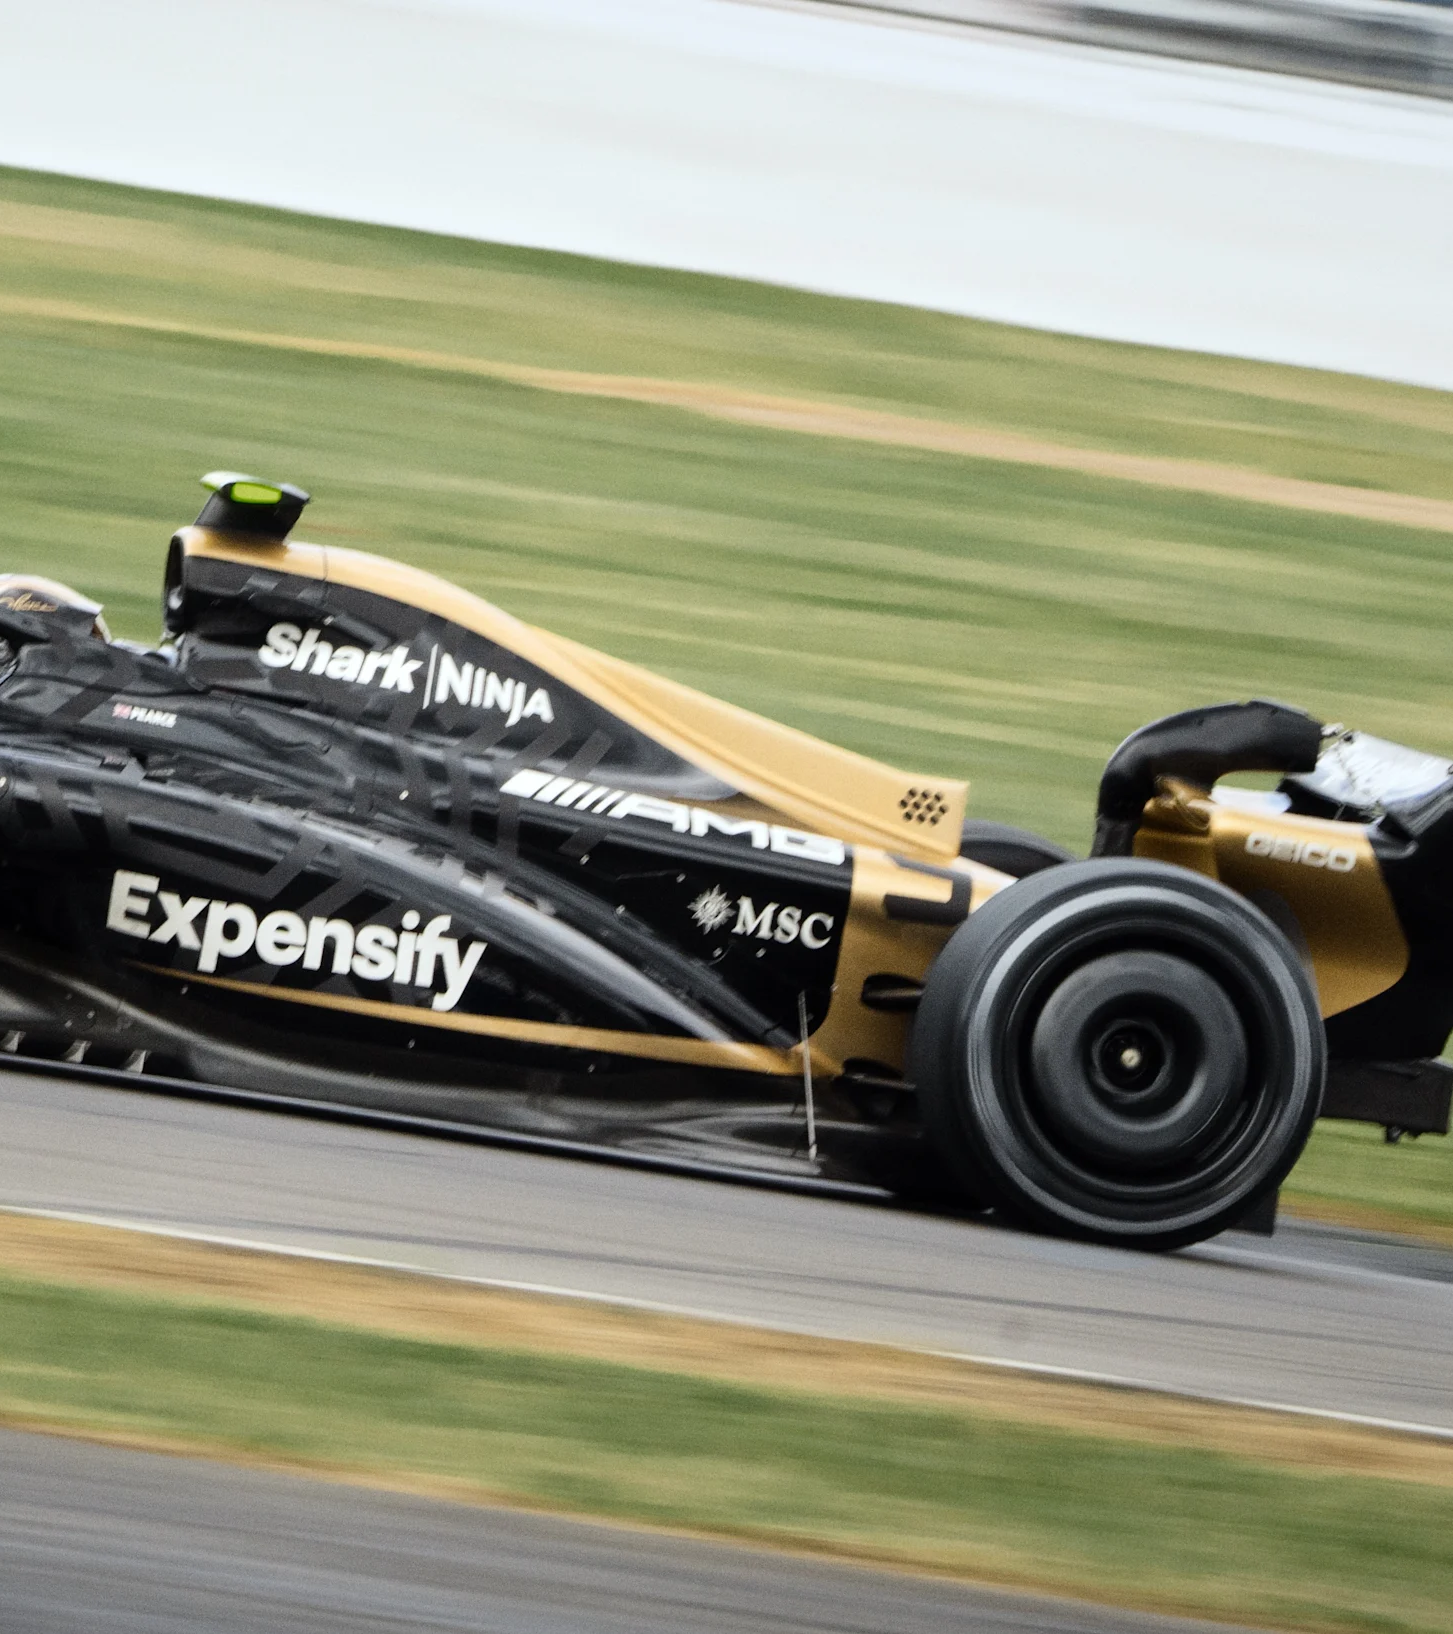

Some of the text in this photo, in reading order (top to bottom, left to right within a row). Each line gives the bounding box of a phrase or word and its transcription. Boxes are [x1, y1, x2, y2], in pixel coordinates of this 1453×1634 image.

[258, 622, 555, 728] Shark NINJA
[607, 792, 846, 866] AMG
[1245, 831, 1357, 873] GEICO
[107, 869, 488, 1011] Expensify
[732, 896, 835, 950] MSC
